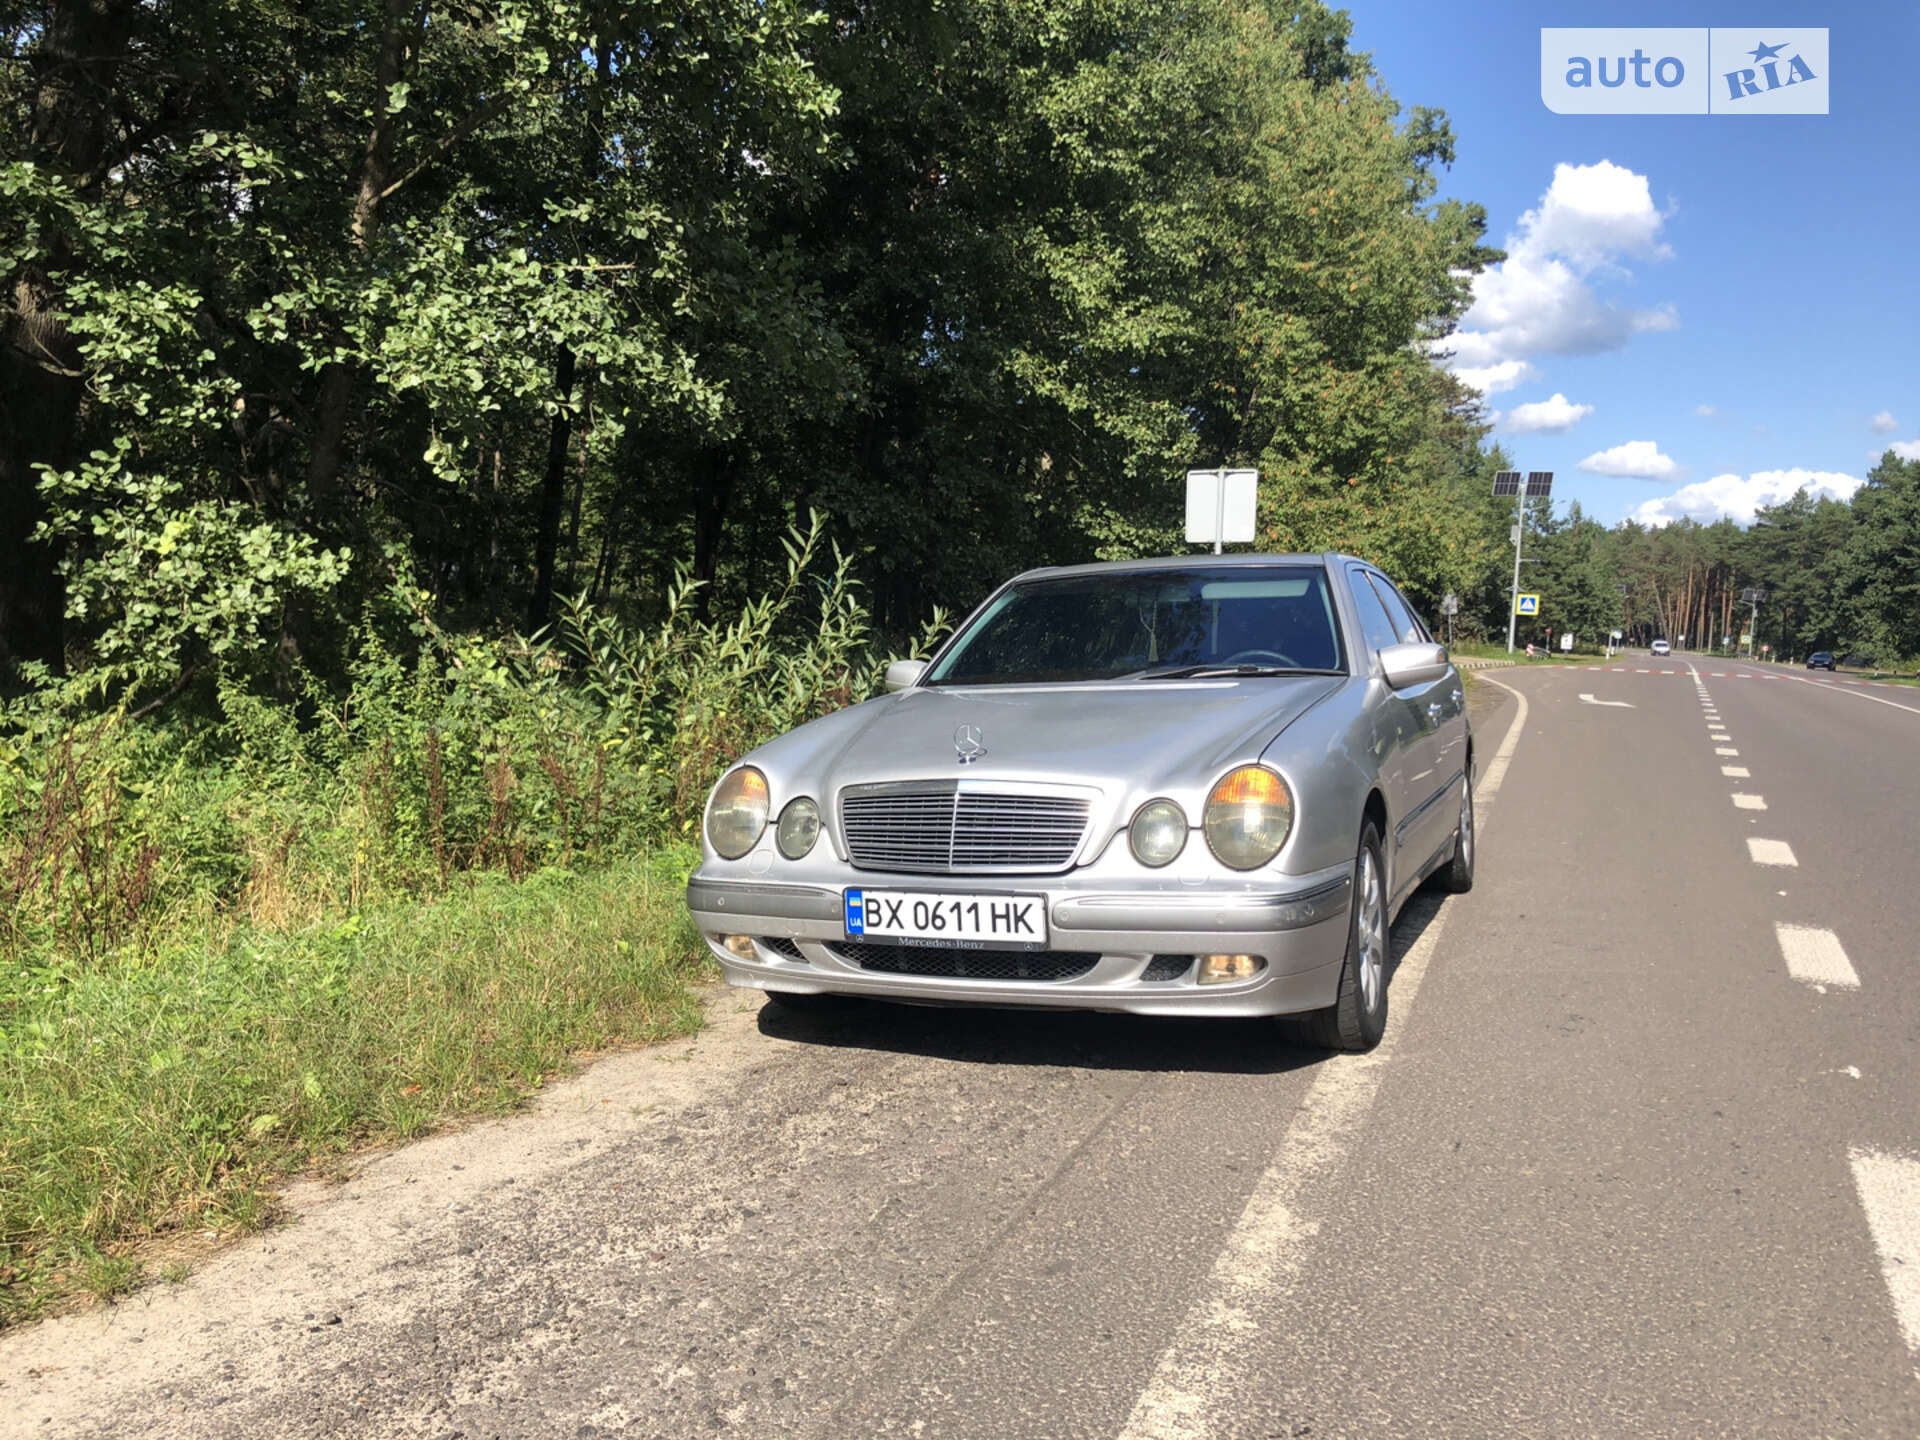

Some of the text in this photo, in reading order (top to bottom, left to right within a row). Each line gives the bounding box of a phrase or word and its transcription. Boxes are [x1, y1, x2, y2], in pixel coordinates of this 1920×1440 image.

[849, 917, 862, 927] UA
[864, 898, 1035, 934] BX 0611 HK
